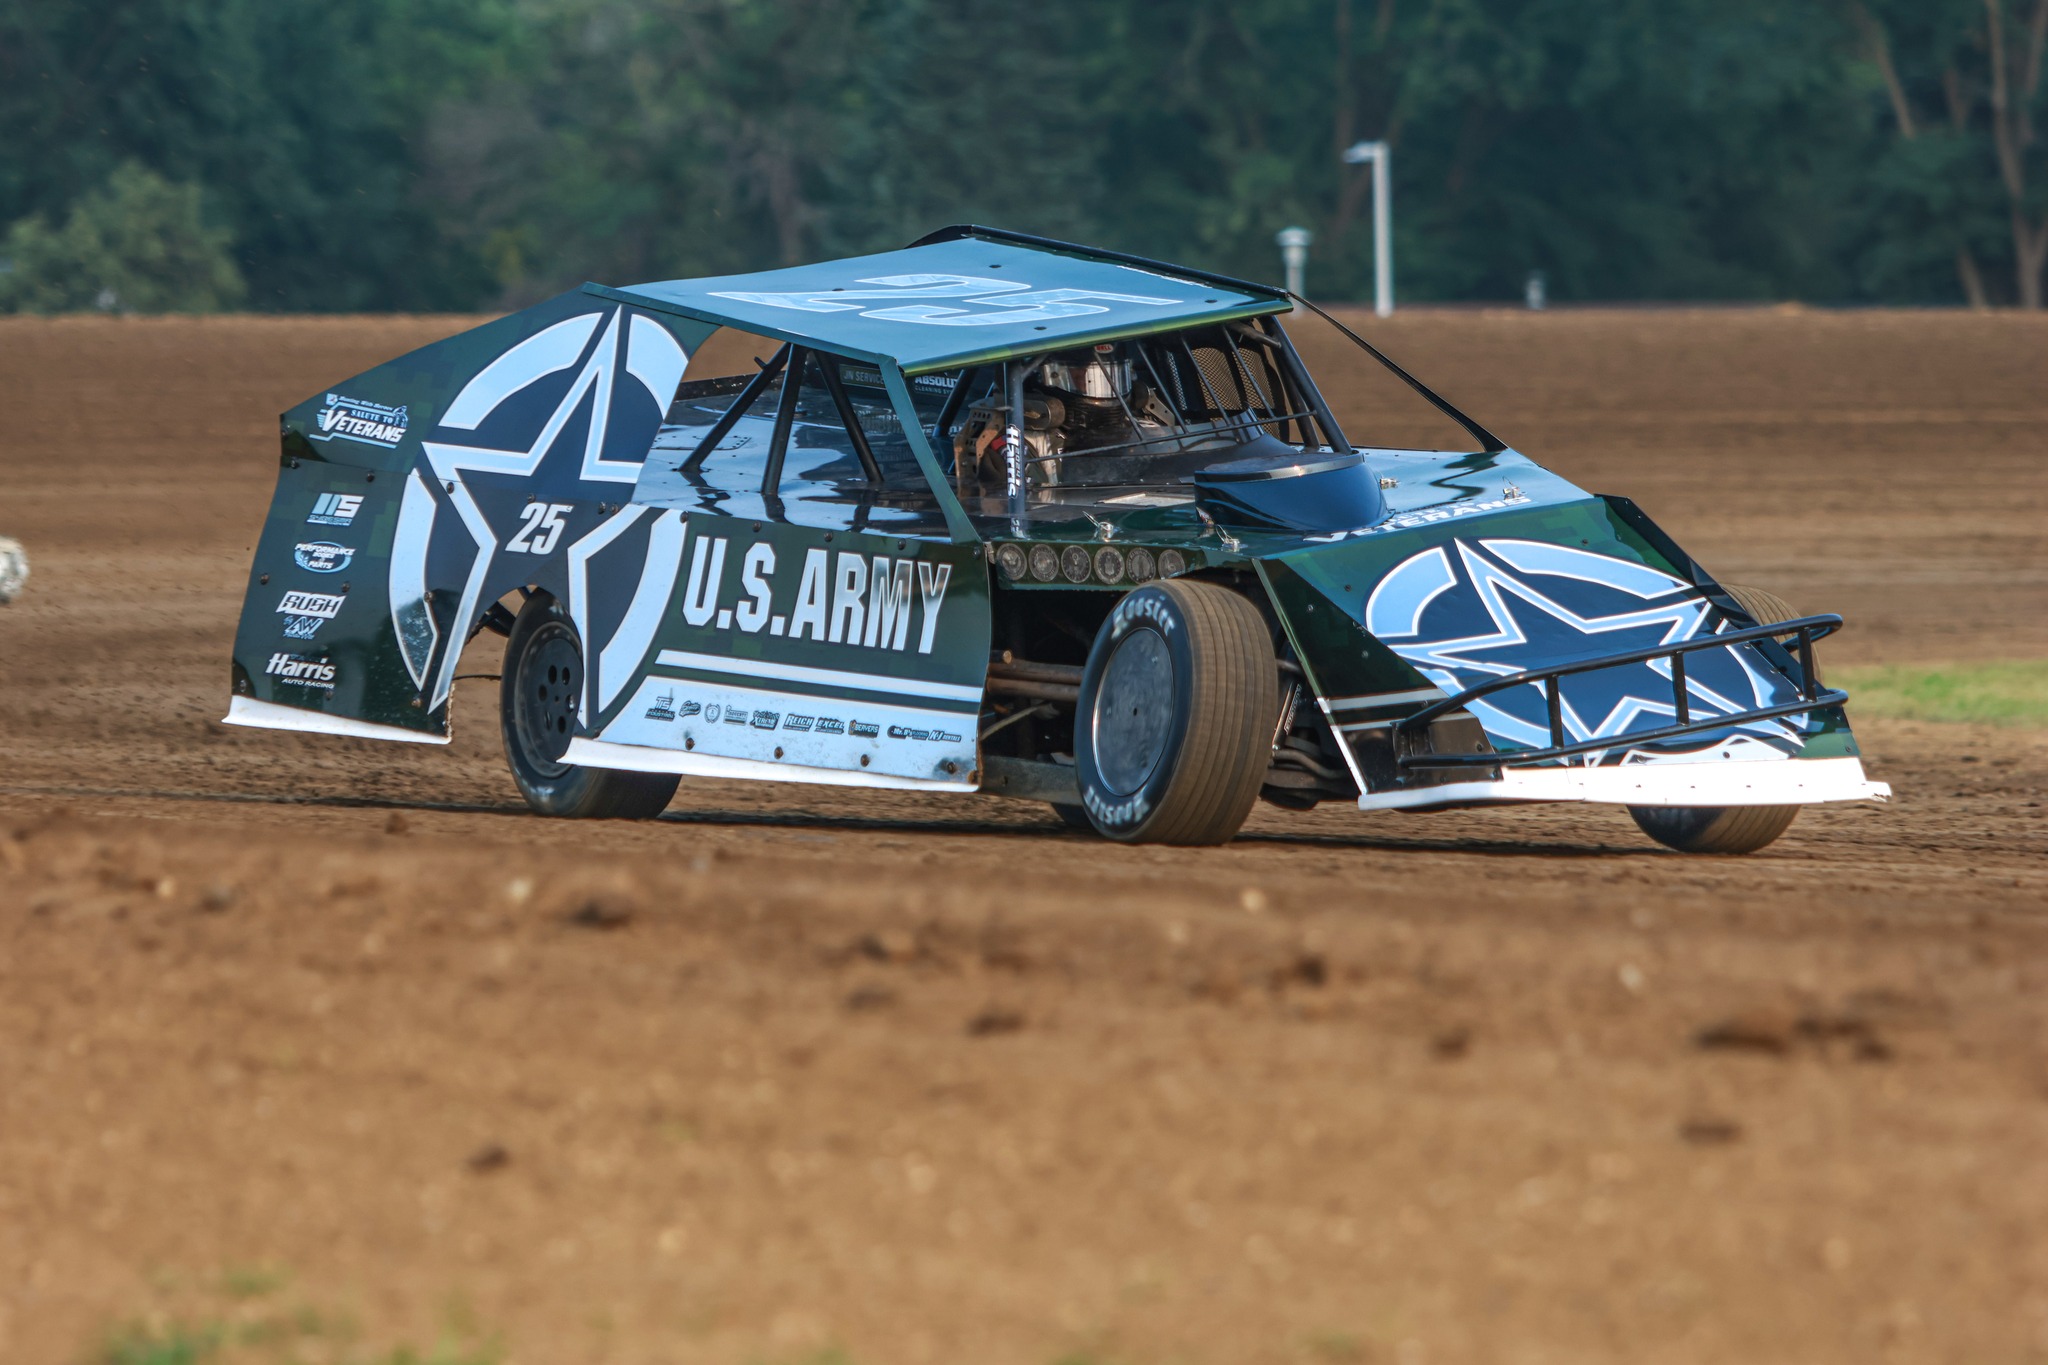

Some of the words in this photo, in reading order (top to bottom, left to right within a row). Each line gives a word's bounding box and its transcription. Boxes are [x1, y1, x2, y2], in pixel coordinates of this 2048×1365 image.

[351, 409, 380, 422] SALUTE
[383, 415, 394, 425] TO
[322, 409, 407, 443] VETERANS
[1006, 425, 1021, 498] Harris
[505, 503, 574, 555] 25
[294, 543, 356, 556] PERFORMANCE
[308, 560, 335, 570] PARTS
[265, 652, 337, 681] Harris
[281, 678, 304, 687] AUTO
[304, 680, 336, 690] RACING
[784, 714, 814, 728] REICH
[816, 720, 845, 729] EXCEL
